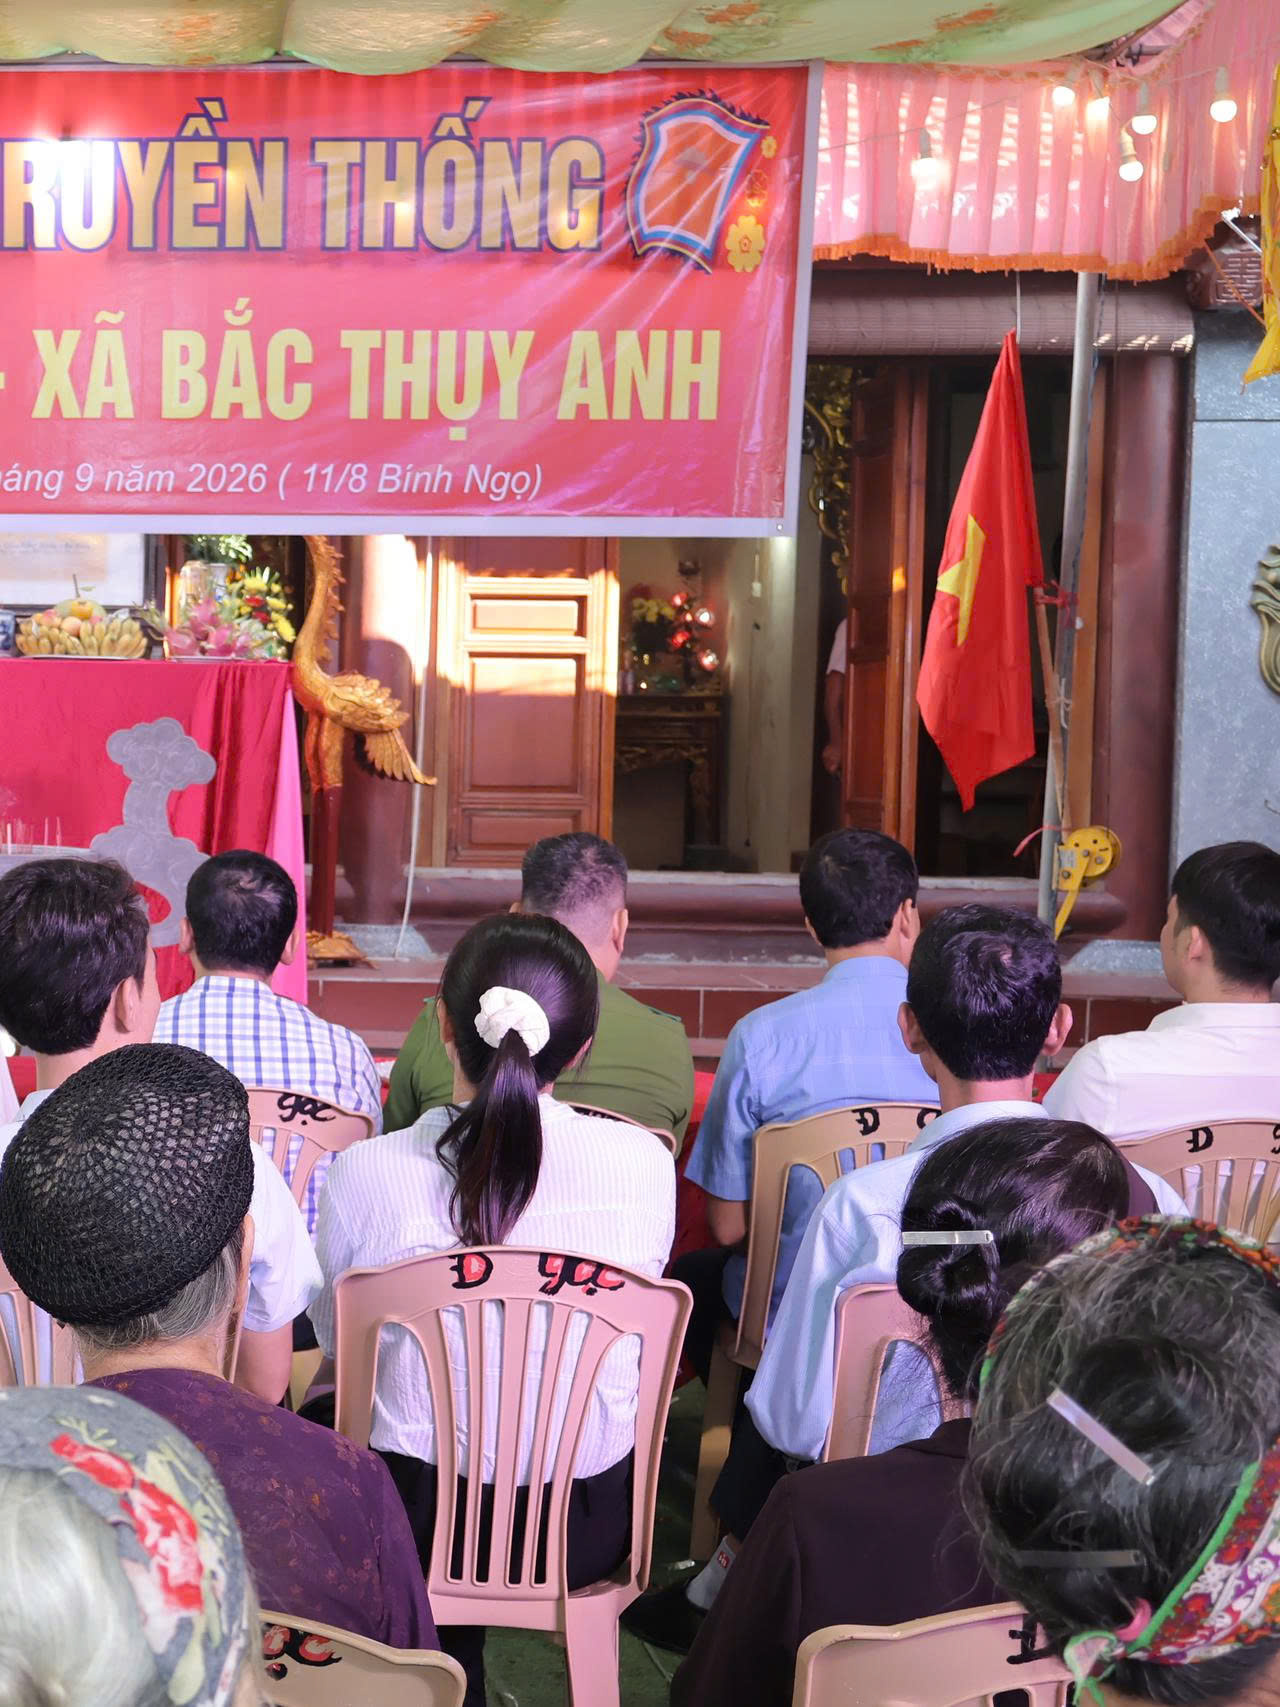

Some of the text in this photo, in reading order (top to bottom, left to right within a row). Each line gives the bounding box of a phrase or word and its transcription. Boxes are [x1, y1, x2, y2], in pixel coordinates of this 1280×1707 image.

[311, 96, 606, 253] THỐNG
[32, 310, 134, 421] XÃ
[161, 297, 313, 422] BẮC
[340, 329, 536, 441] THỤY
[556, 329, 721, 421] ANH
[74, 463, 94, 493] 9
[103, 463, 176, 493] năm
[186, 463, 267, 493] 2026
[303, 462, 367, 493] 11/8
[377, 463, 453, 494] Bính
[463, 463, 543, 502] Ngọ)
[277, 1093, 336, 1126] gọc
[851, 1108, 880, 1136] Đ
[1186, 1127, 1214, 1153] Đ
[448, 1252, 625, 1296] Đ gọc
[261, 1622, 342, 1681] ọc
